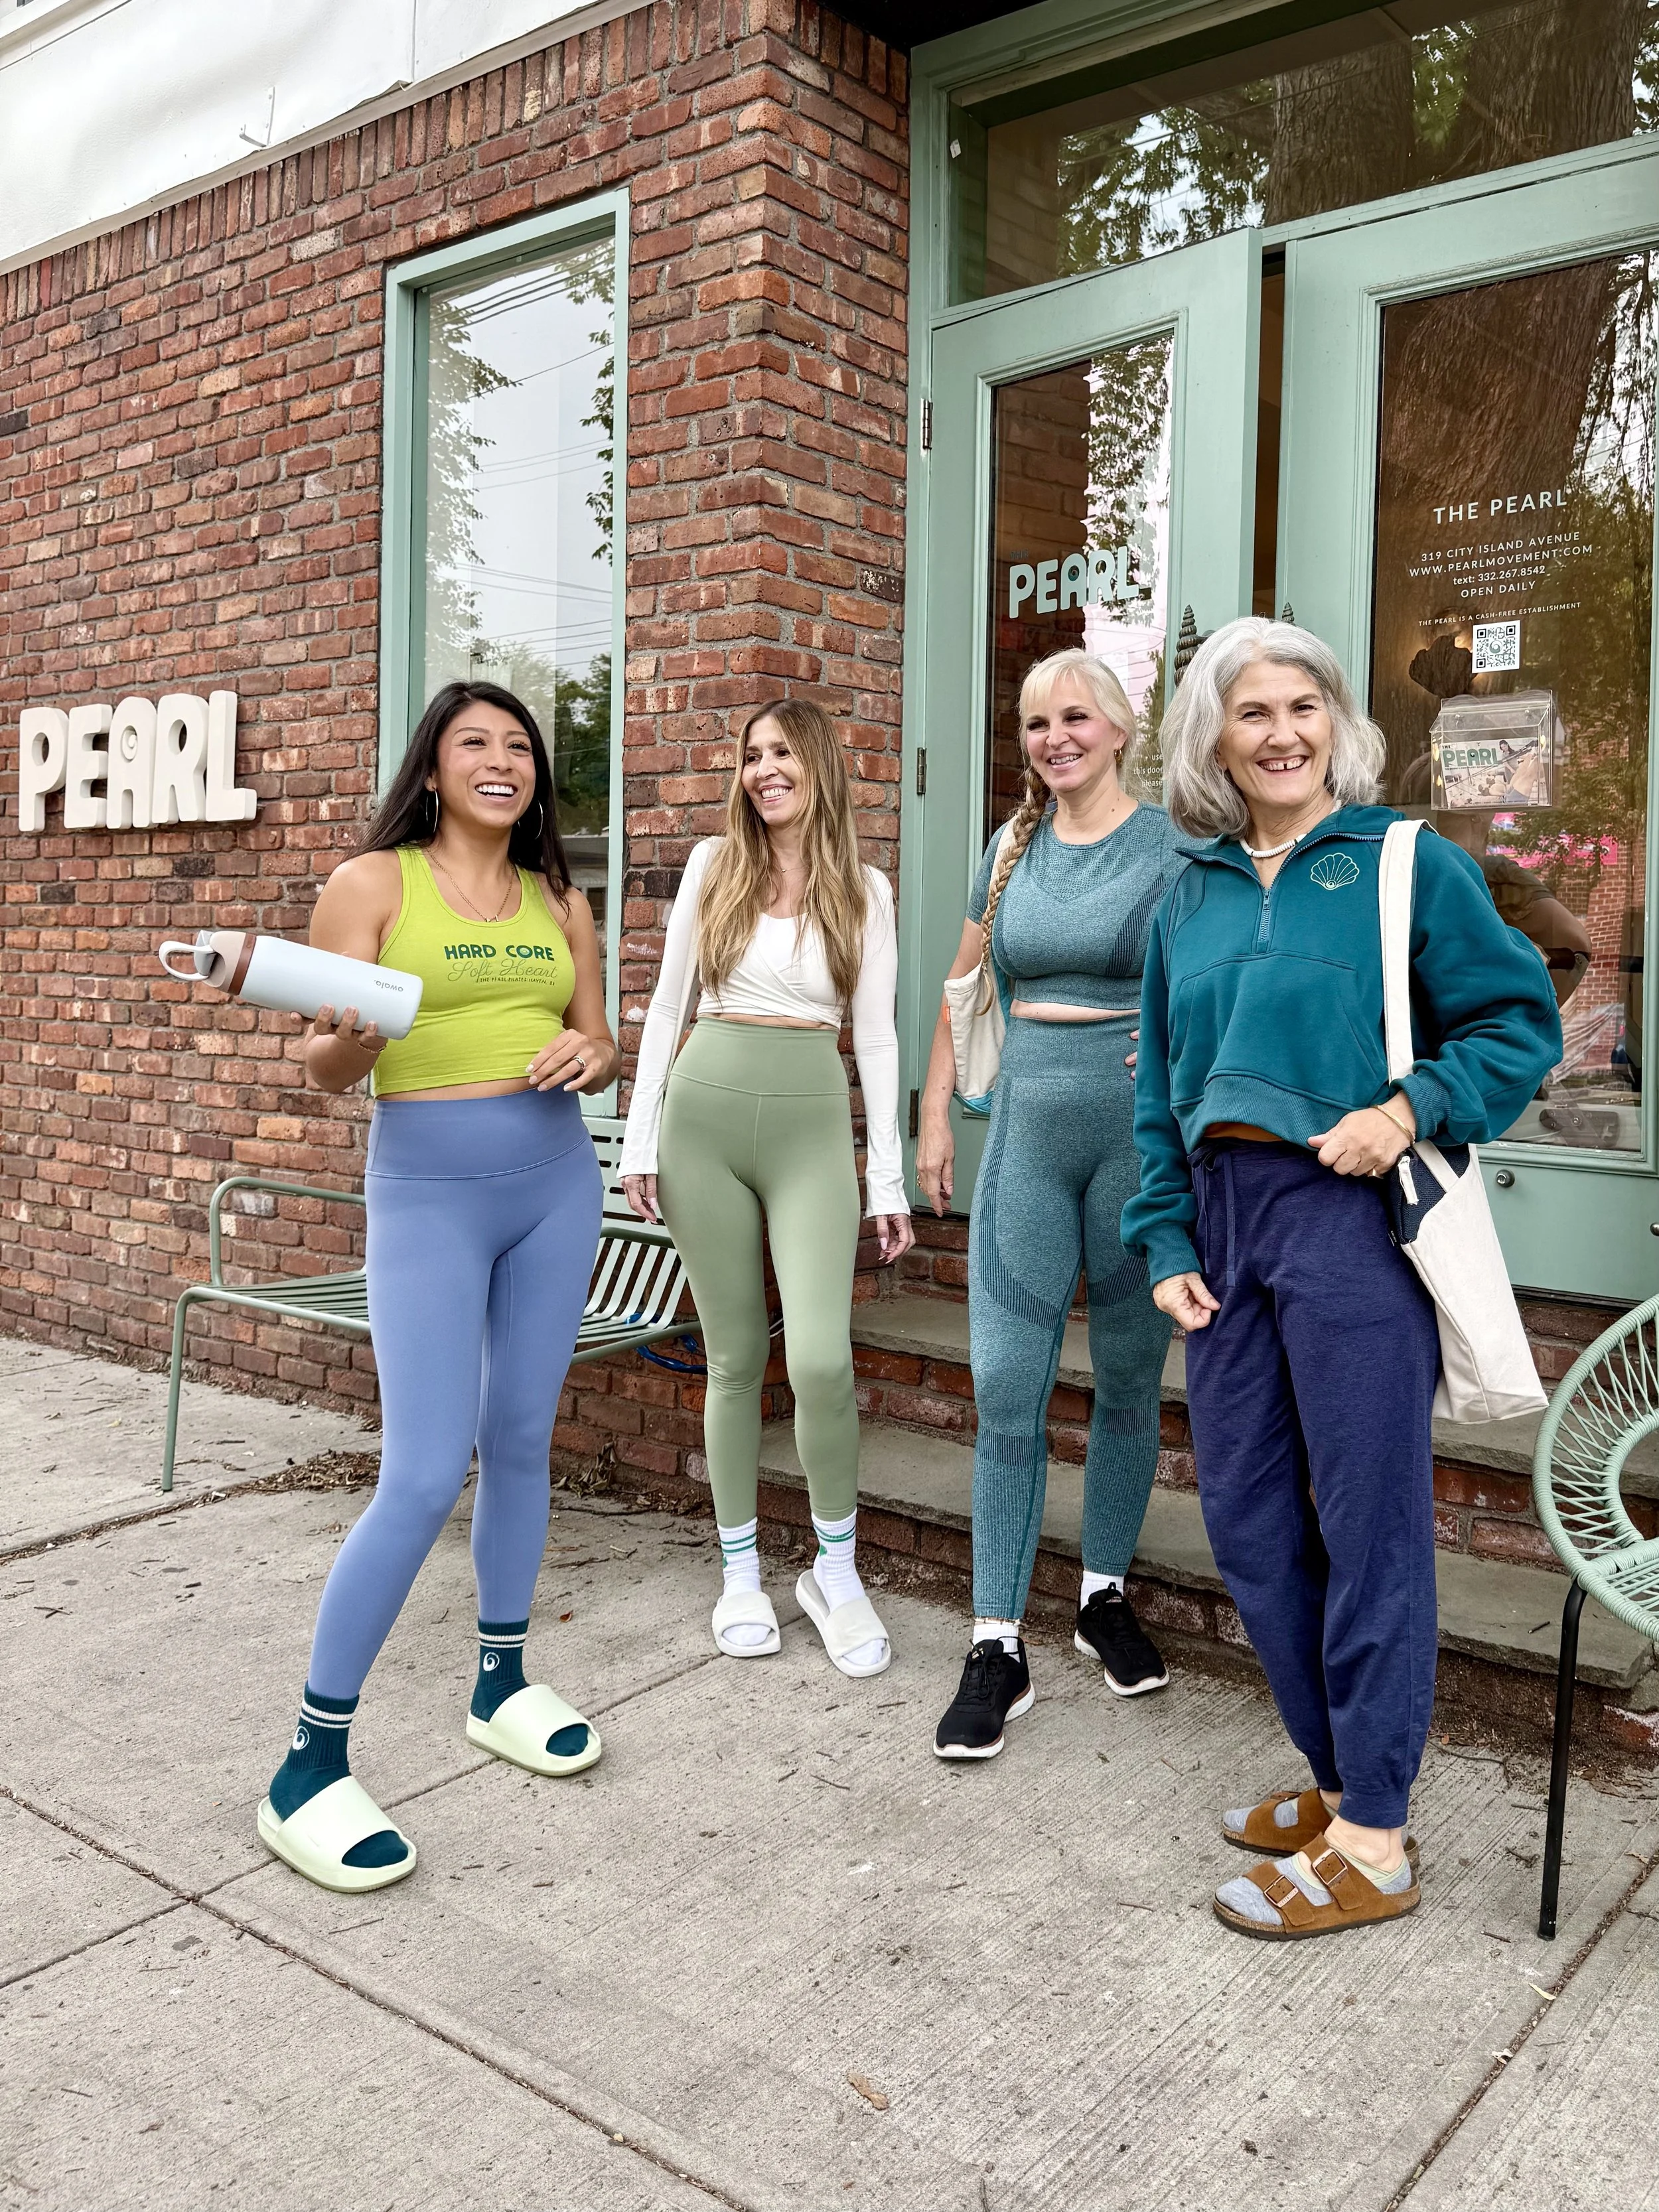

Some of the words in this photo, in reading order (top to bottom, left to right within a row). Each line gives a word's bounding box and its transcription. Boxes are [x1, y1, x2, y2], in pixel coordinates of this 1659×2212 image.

[1433, 501, 1479, 524] THE
[1490, 489, 1567, 516] PEARL
[1421, 551, 1441, 562] 319
[1447, 546, 1473, 558] CITY
[1479, 540, 1523, 554] ISLAND
[1529, 531, 1579, 547] AVENUE
[1409, 544, 1592, 577] WWW.PEARLMOVEMENT.COM
[1009, 545, 1139, 619] PEARL
[1453, 575, 1475, 585] text:
[1478, 565, 1546, 582] 332.267.8542
[1461, 586, 1493, 598] OPEN
[1499, 581, 1536, 593] DAILY
[1475, 610, 1516, 620] CASH-FREE
[1519, 602, 1581, 615] ESTABLISHMENT
[18, 689, 257, 832] PEARL
[1443, 748, 1502, 768] PEARL
[444, 944, 496, 959] HARD
[506, 945, 555, 961] CORE
[447, 959, 494, 983] Soft
[498, 958, 558, 979] Heart
